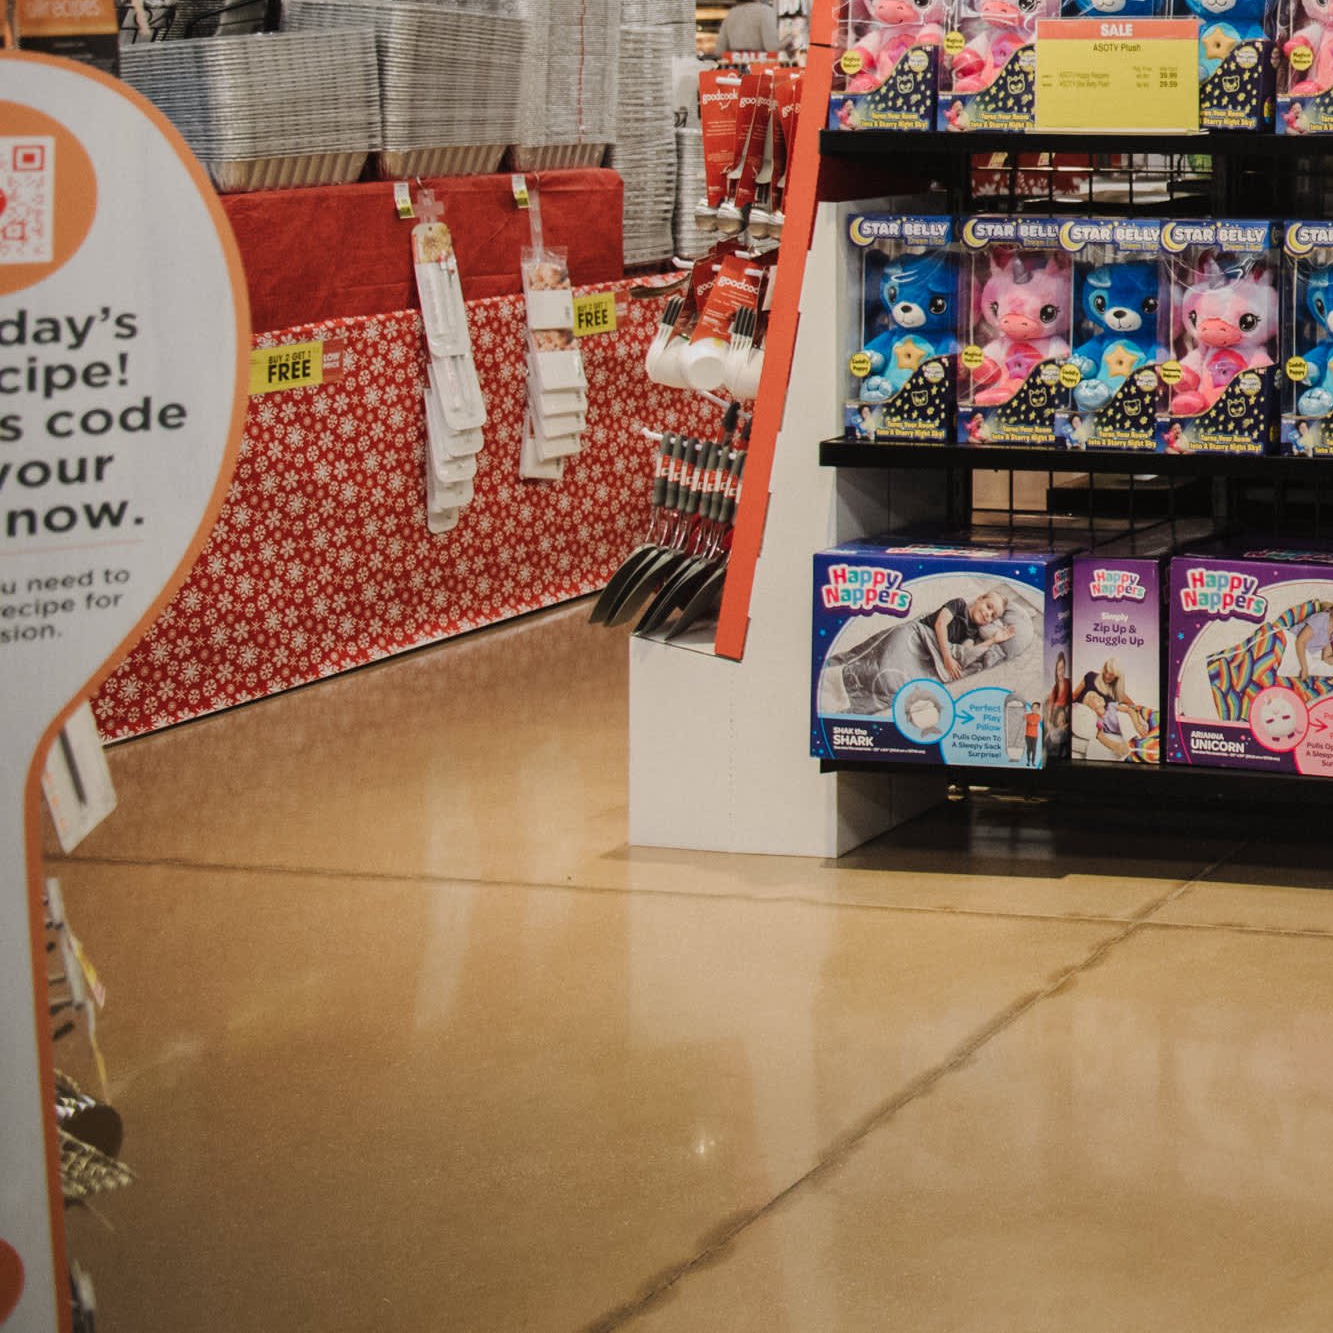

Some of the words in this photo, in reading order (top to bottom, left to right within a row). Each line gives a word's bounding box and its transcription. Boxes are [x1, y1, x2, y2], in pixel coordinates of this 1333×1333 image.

[1100, 23, 1133, 37] SALE
[1121, 44, 1141, 52] Plush
[862, 222, 899, 236] STAR
[903, 222, 949, 236] BELLY
[976, 224, 1014, 237] STAR
[1071, 226, 1111, 240] STAR
[1116, 227, 1160, 242] BELLY
[1174, 228, 1214, 242] STAR
[1219, 228, 1265, 243] BELLY
[718, 276, 759, 295] goodcoo
[578, 309, 608, 328] FREE
[268, 355, 283, 364] BUY
[292, 352, 305, 362] GET
[0, 353, 128, 399] cipe!
[267, 360, 311, 383] FREE
[46, 397, 187, 438] code
[6, 500, 144, 538] now.
[27, 569, 94, 593] need
[104, 568, 130, 584] to
[831, 567, 900, 589] Happy
[1096, 570, 1138, 585] Happy
[1189, 570, 1258, 595] Happy
[824, 587, 909, 608] Nappers
[1091, 583, 1144, 597] Nappers
[86, 593, 123, 610] for
[1183, 592, 1266, 614] Nappers
[1093, 623, 1110, 635] Zip
[1112, 624, 1127, 635] Up
[1128, 625, 1137, 634] &
[1085, 634, 1127, 647] Snuggle
[1129, 636, 1144, 647] Up
[833, 726, 853, 735] SHAK
[854, 727, 867, 735] the
[952, 733, 970, 741] Pulls
[971, 734, 991, 743] Open
[1191, 730, 1224, 741] ARIANNA
[833, 734, 874, 747] SHARK
[958, 742, 982, 752] Sleepy
[1191, 739, 1245, 754] UNICORN
[1307, 742, 1324, 751] Pulls
